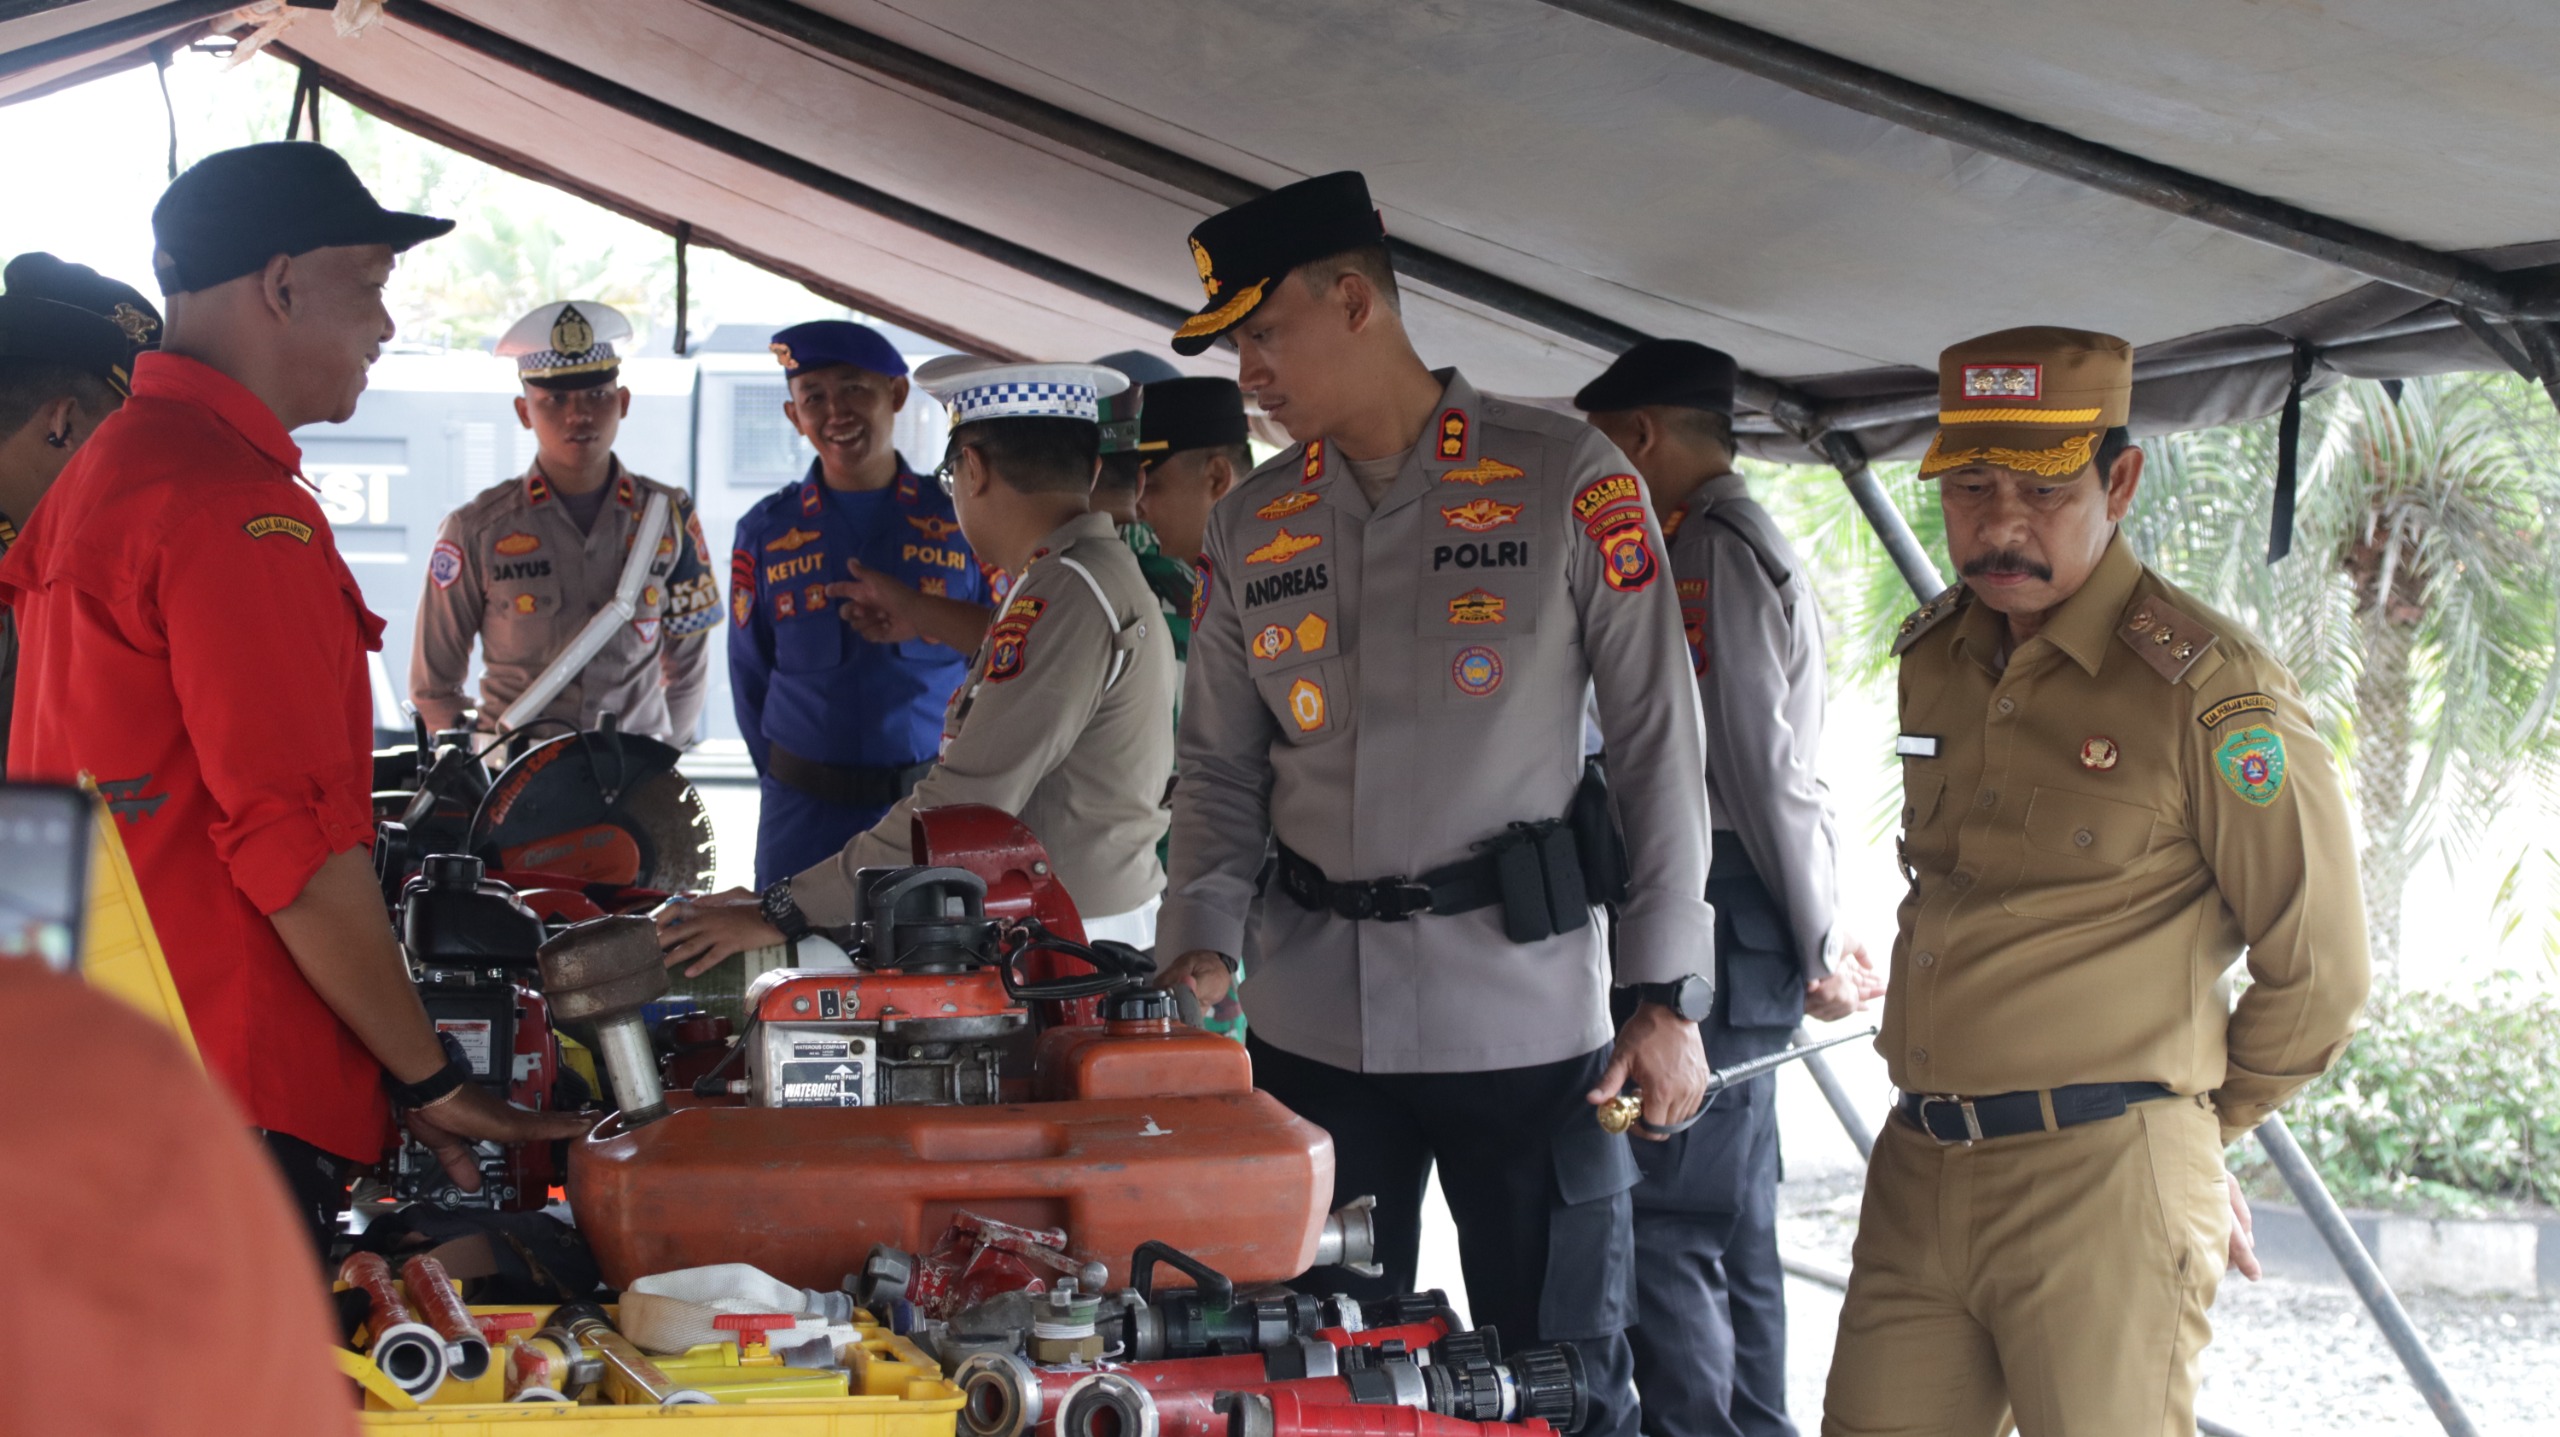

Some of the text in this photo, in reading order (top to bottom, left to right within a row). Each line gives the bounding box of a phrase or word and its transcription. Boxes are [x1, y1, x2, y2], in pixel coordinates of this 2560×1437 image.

[1576, 478, 1636, 513] POLRES
[493, 560, 552, 581] JAYUS
[766, 552, 825, 585] KETUT
[902, 544, 966, 571] POLRI
[1434, 541, 1528, 572] POLRI
[1245, 563, 1329, 610] ANDREAS
[784, 1083, 838, 1098] WATEROUS
